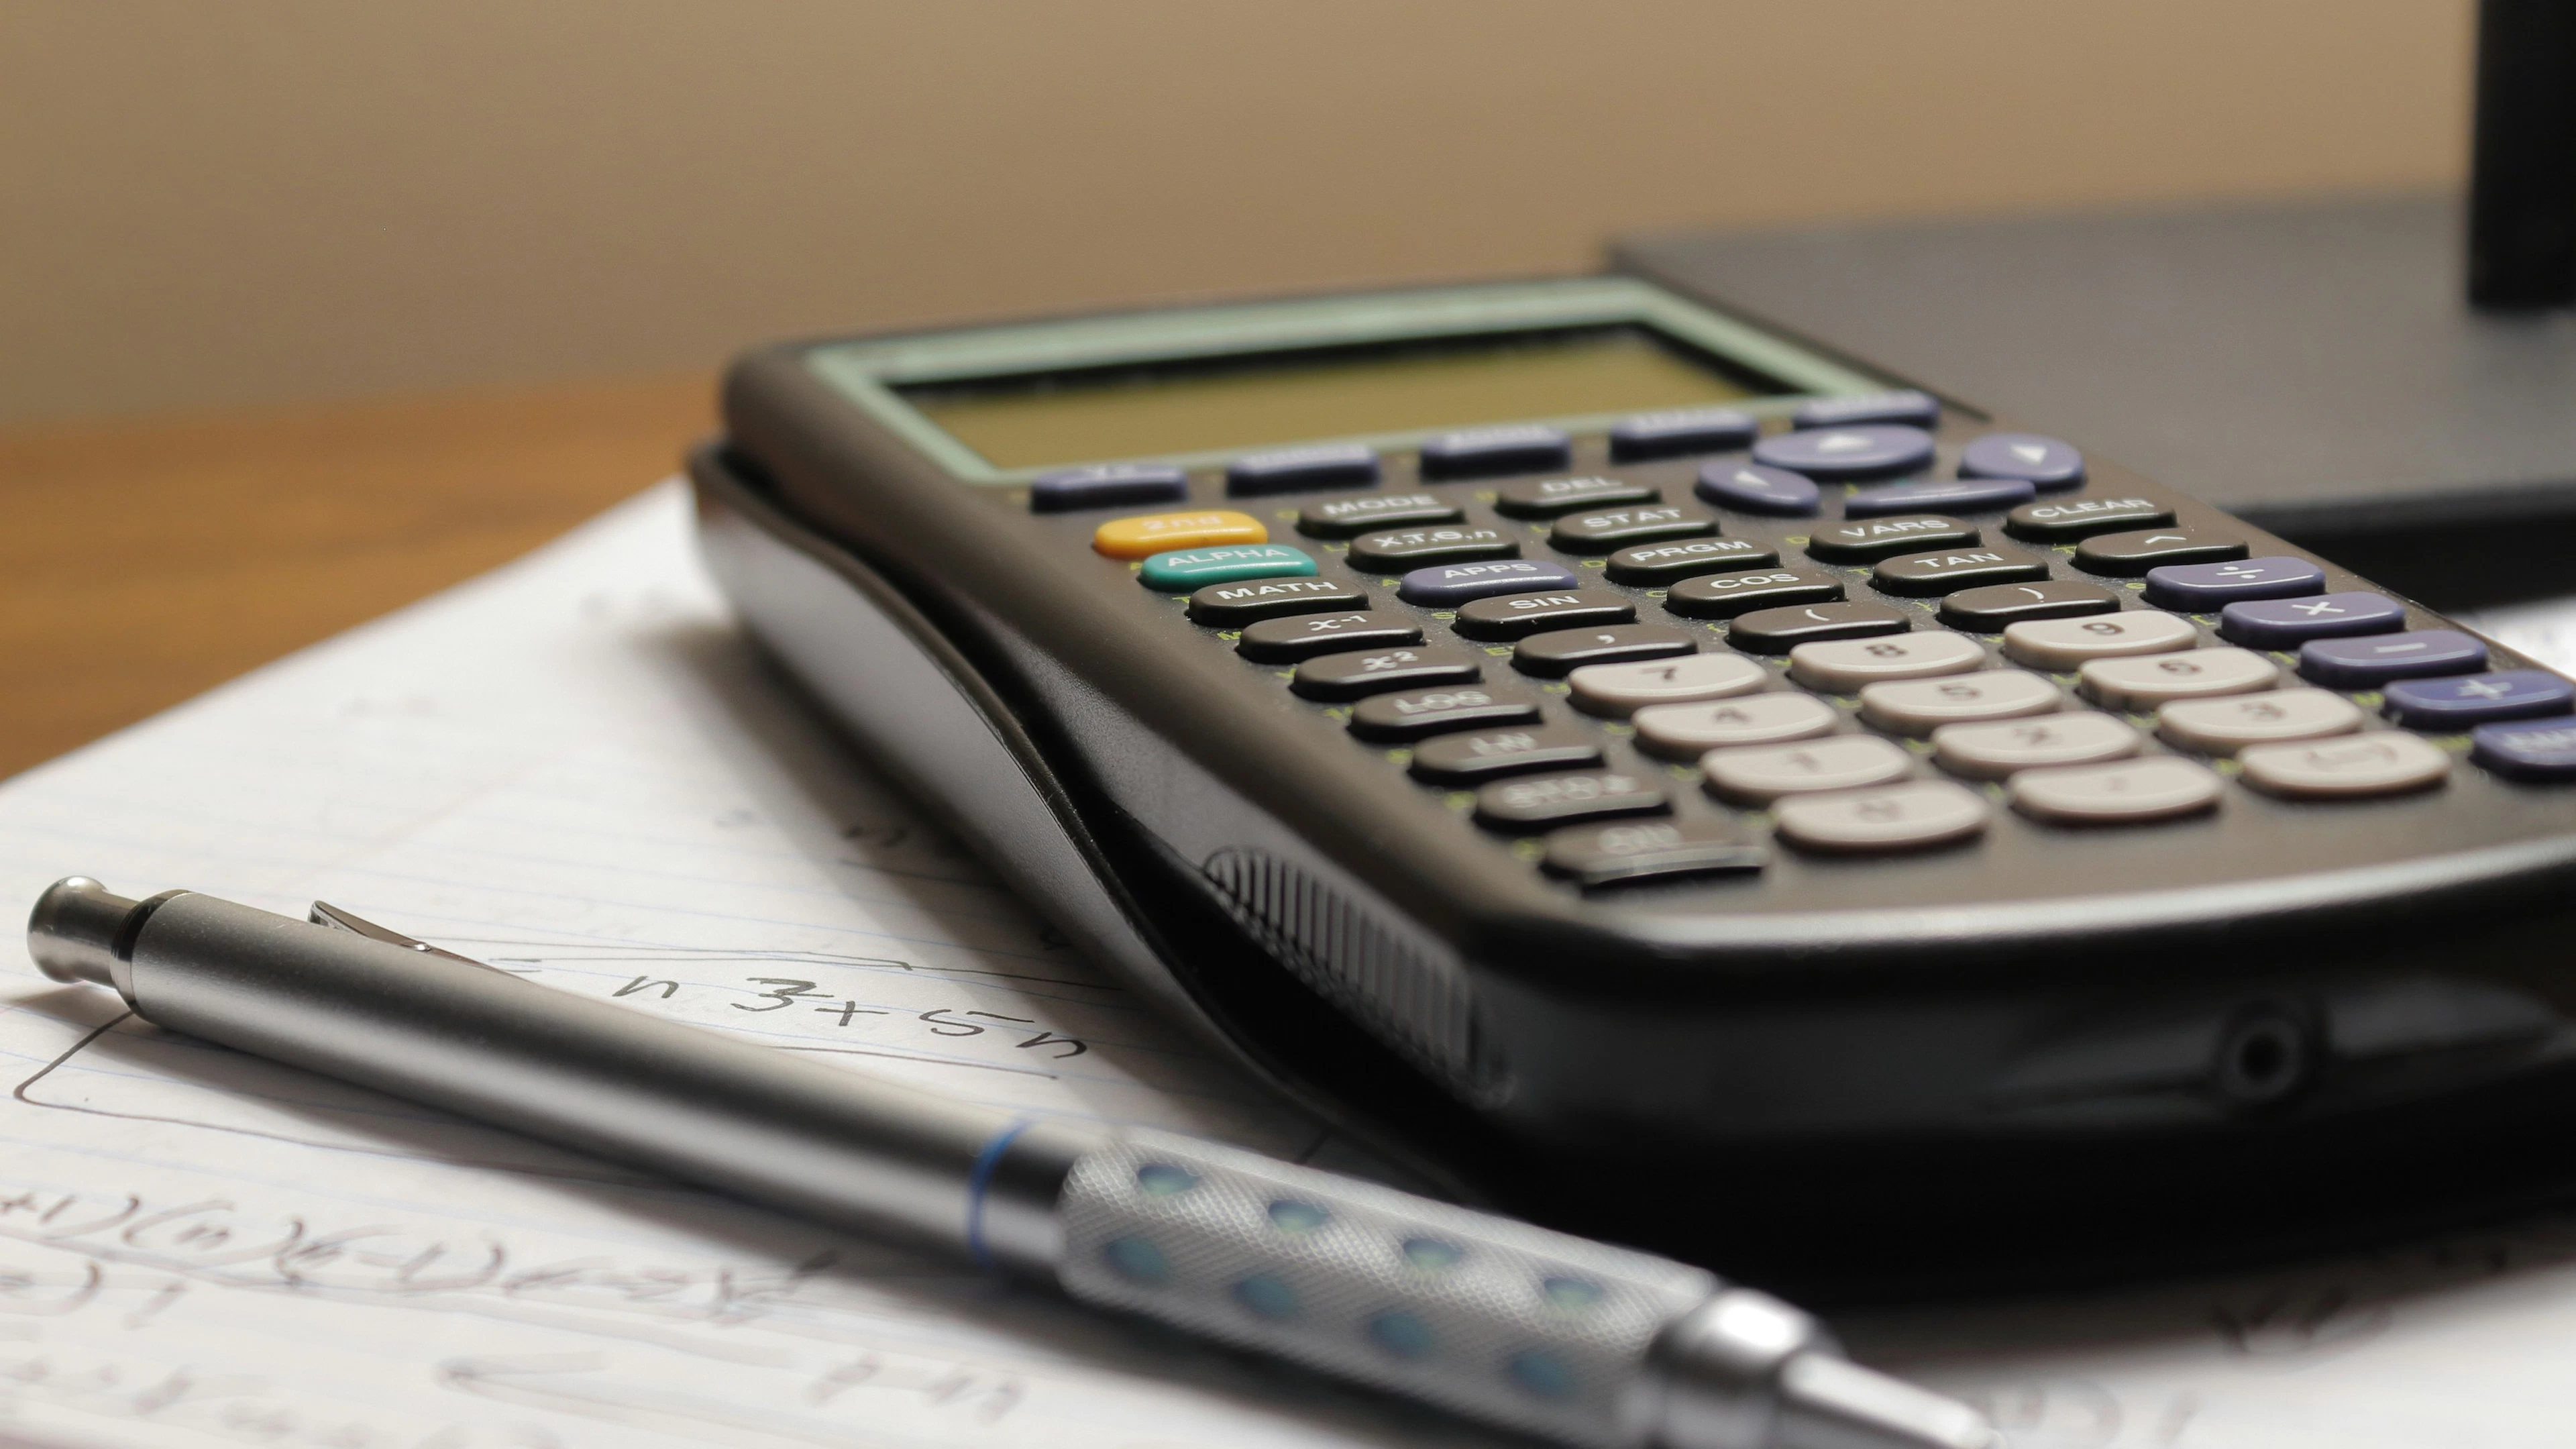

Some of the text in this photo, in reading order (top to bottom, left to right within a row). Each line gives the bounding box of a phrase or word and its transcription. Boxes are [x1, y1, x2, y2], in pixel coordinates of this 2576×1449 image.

[1541, 477, 1623, 492] DEL
[1323, 494, 1439, 515] MODE
[2031, 499, 2155, 519] CLEAR
[1142, 515, 1222, 530] 2nd
[1583, 508, 1680, 527] STAT
[1840, 520, 1949, 537] VARS
[1168, 548, 1289, 566] ALPHA
[1630, 541, 1752, 561] PRGM
[1914, 553, 2004, 568] TAN
[1444, 564, 1538, 578] APPS
[1711, 574, 1799, 589] COS
[1216, 581, 1338, 600] MATH
[1509, 595, 1580, 609] SIN
[2082, 622, 2125, 635] 9
[1395, 690, 1491, 714] LOG
